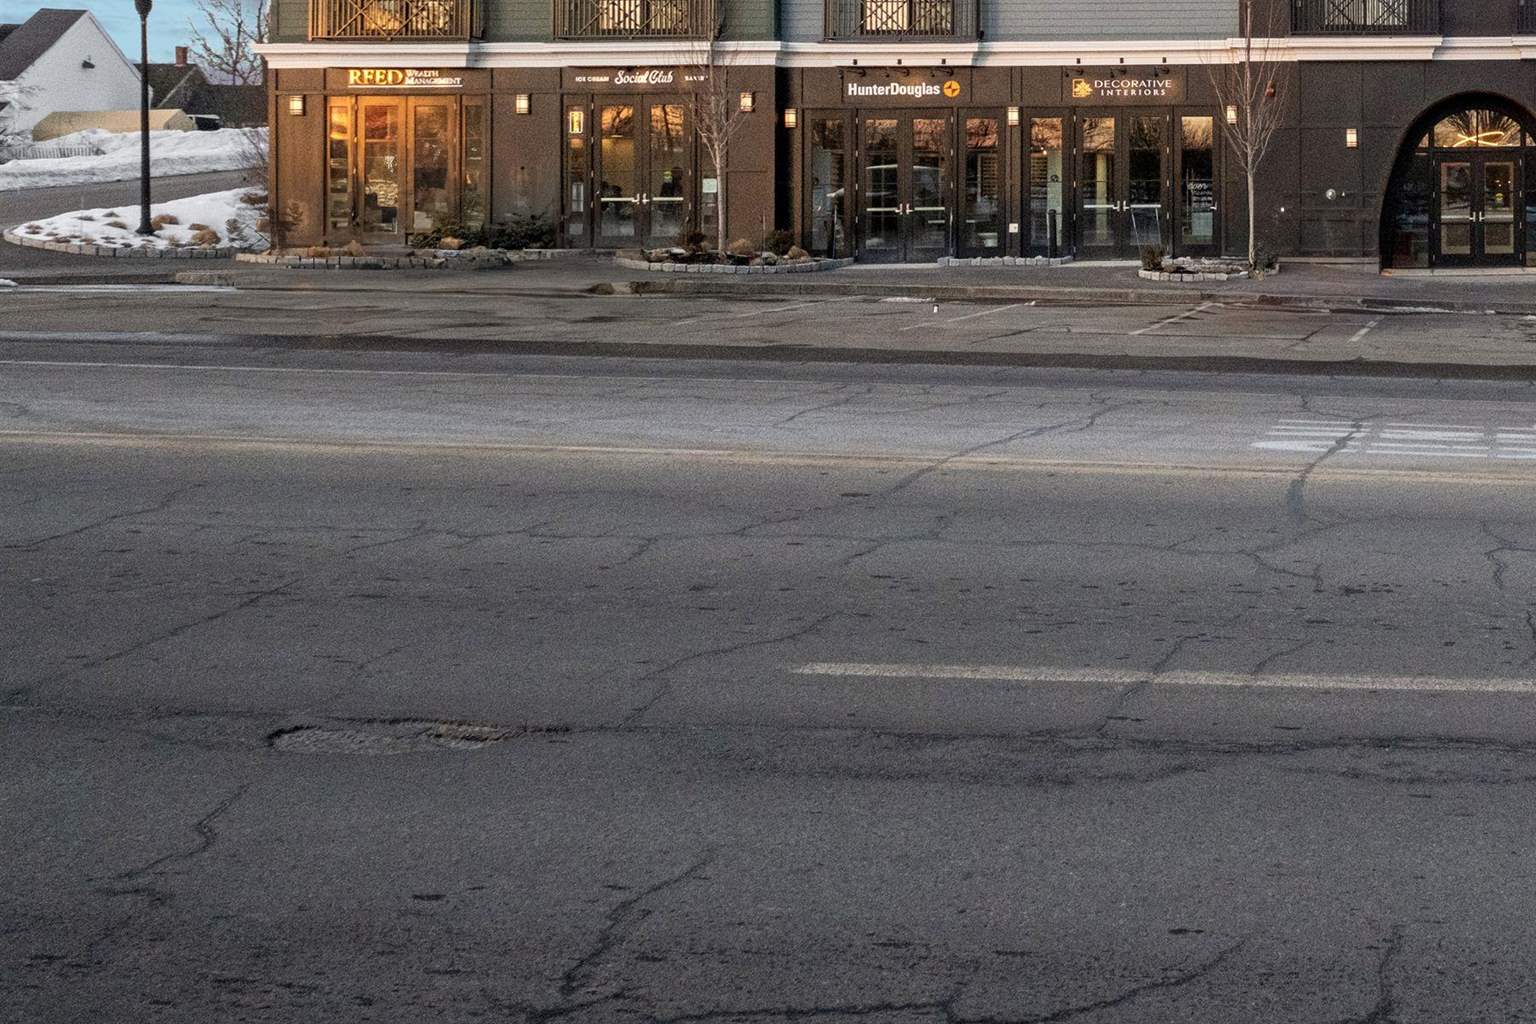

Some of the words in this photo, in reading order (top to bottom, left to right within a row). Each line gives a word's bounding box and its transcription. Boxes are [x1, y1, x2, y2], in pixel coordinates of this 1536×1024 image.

[348, 69, 404, 85] REED
[614, 69, 648, 84] Social
[648, 69, 674, 84] Club
[1094, 79, 1172, 88] DECORATIVE
[847, 82, 941, 98] HunterDouglas
[1100, 88, 1166, 96] INTERIORS
